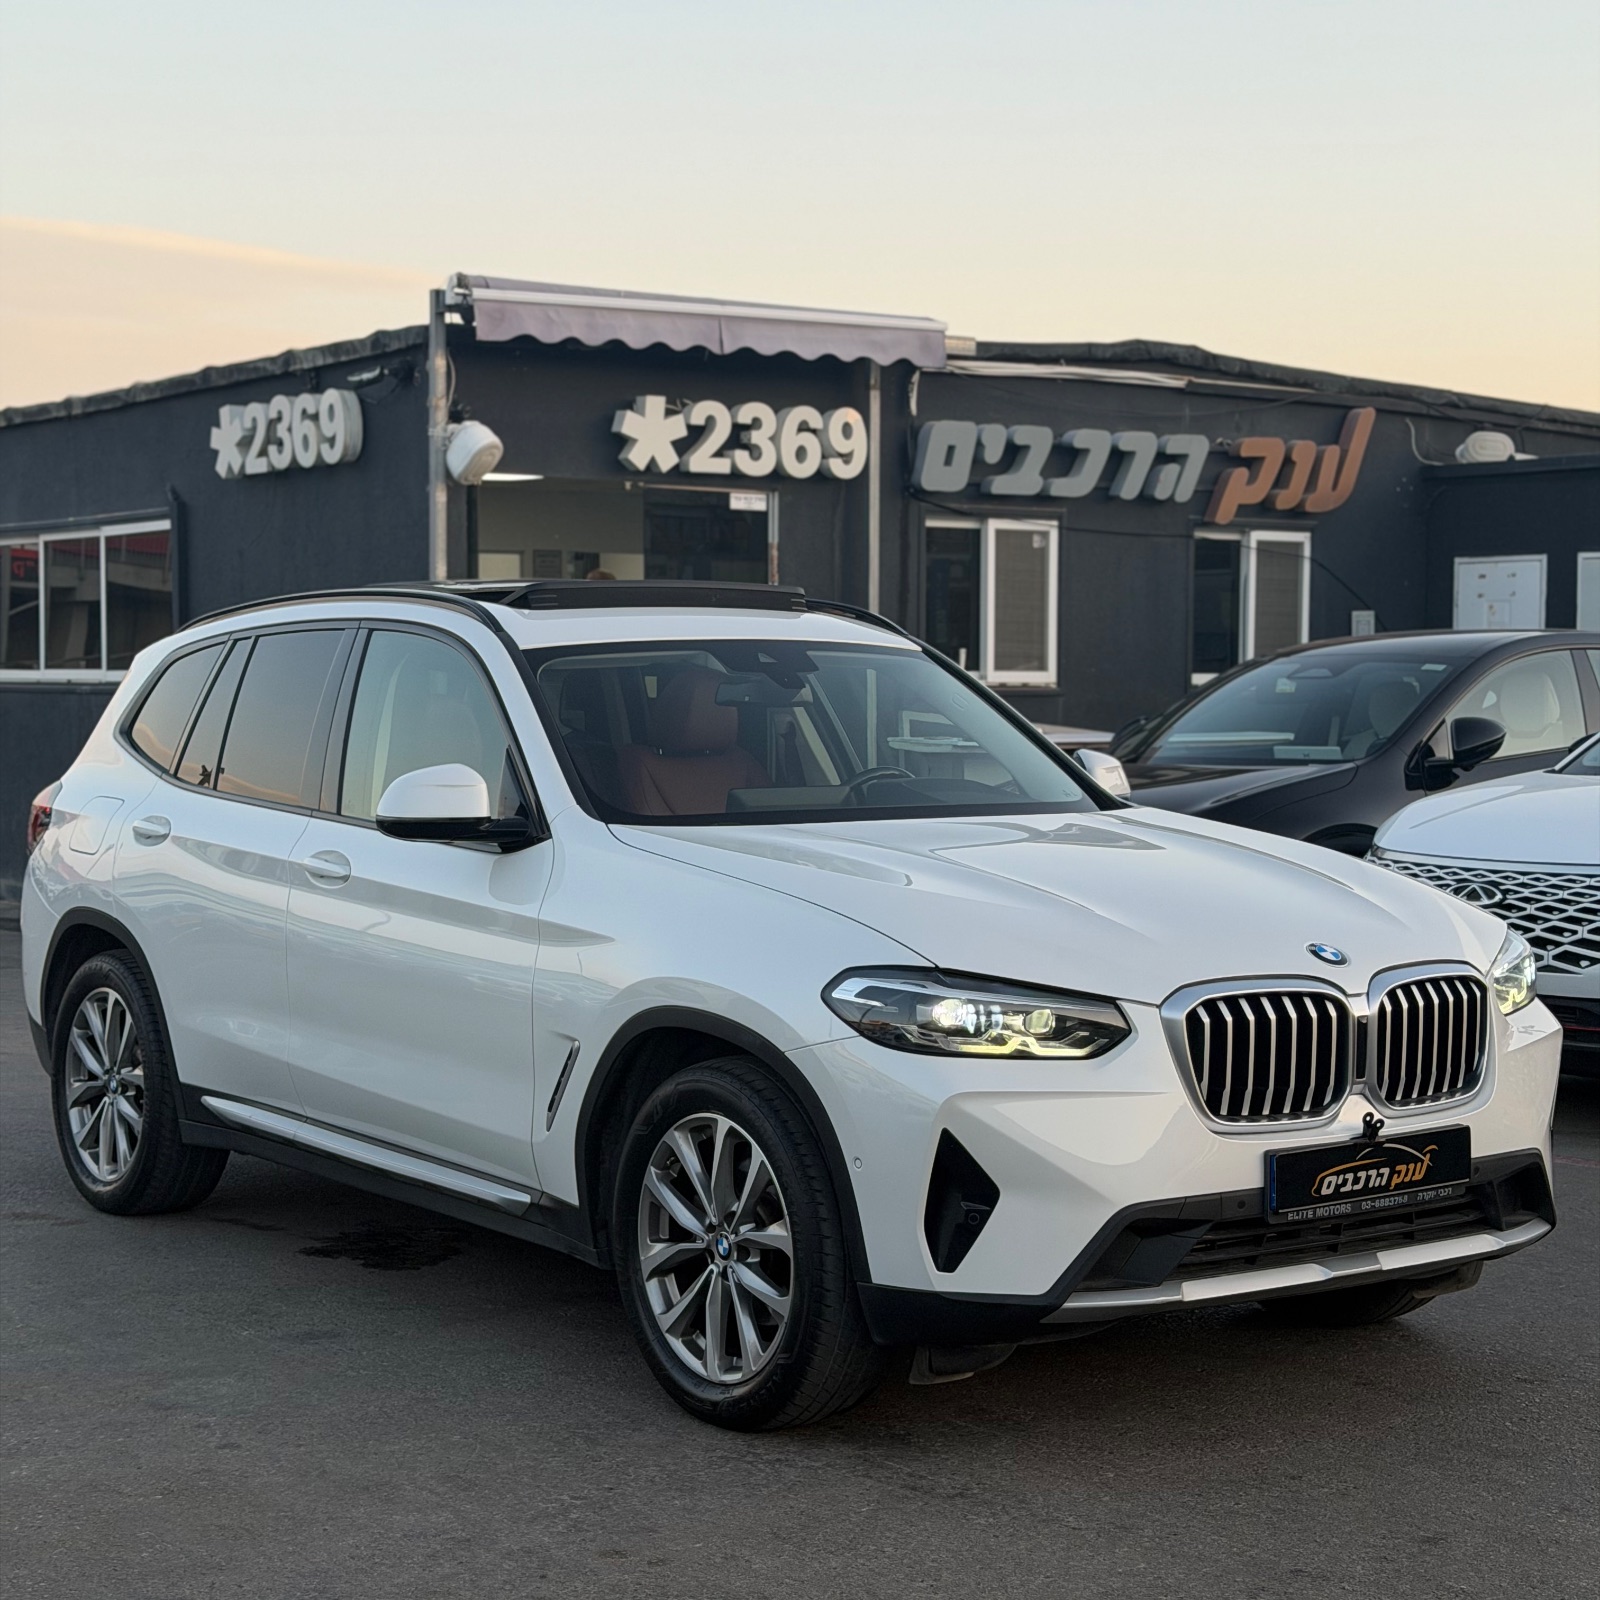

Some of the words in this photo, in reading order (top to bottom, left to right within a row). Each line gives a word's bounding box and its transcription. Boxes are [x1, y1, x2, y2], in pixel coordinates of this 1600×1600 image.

[915, 420, 1210, 503] הרכבים
[1208, 407, 1377, 525] ענק
[1320, 1167, 1390, 1196] הרכבים
[1389, 1153, 1431, 1190] ענק
[1287, 1209, 1314, 1221] ELITE
[1315, 1203, 1352, 1218] MOTORS
